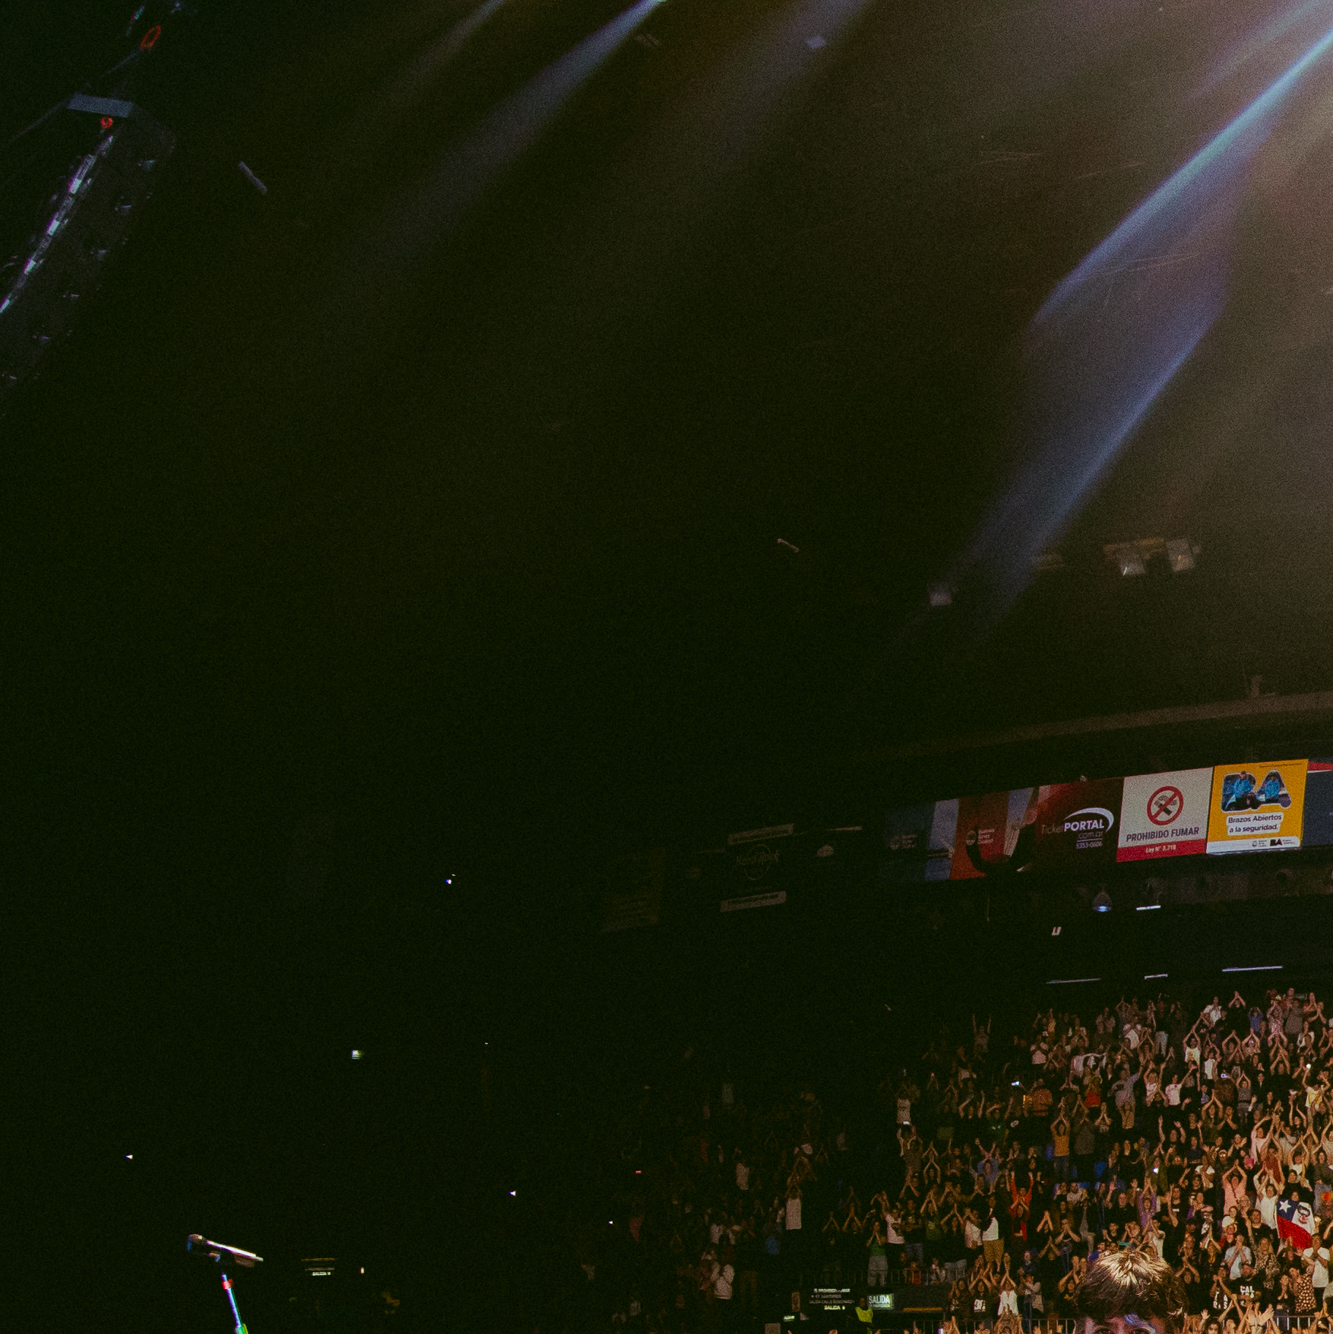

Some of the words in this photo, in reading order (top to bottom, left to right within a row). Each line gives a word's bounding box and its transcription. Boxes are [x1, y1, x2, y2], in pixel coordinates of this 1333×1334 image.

[1228, 815, 1251, 824] Brazos
[1253, 813, 1282, 823] Abiertos
[1126, 830, 1169, 842] PROHIBIDO
[1171, 826, 1199, 838] FUMAR
[1235, 825, 1242, 833] la
[868, 1295, 890, 1305] SALIDA
